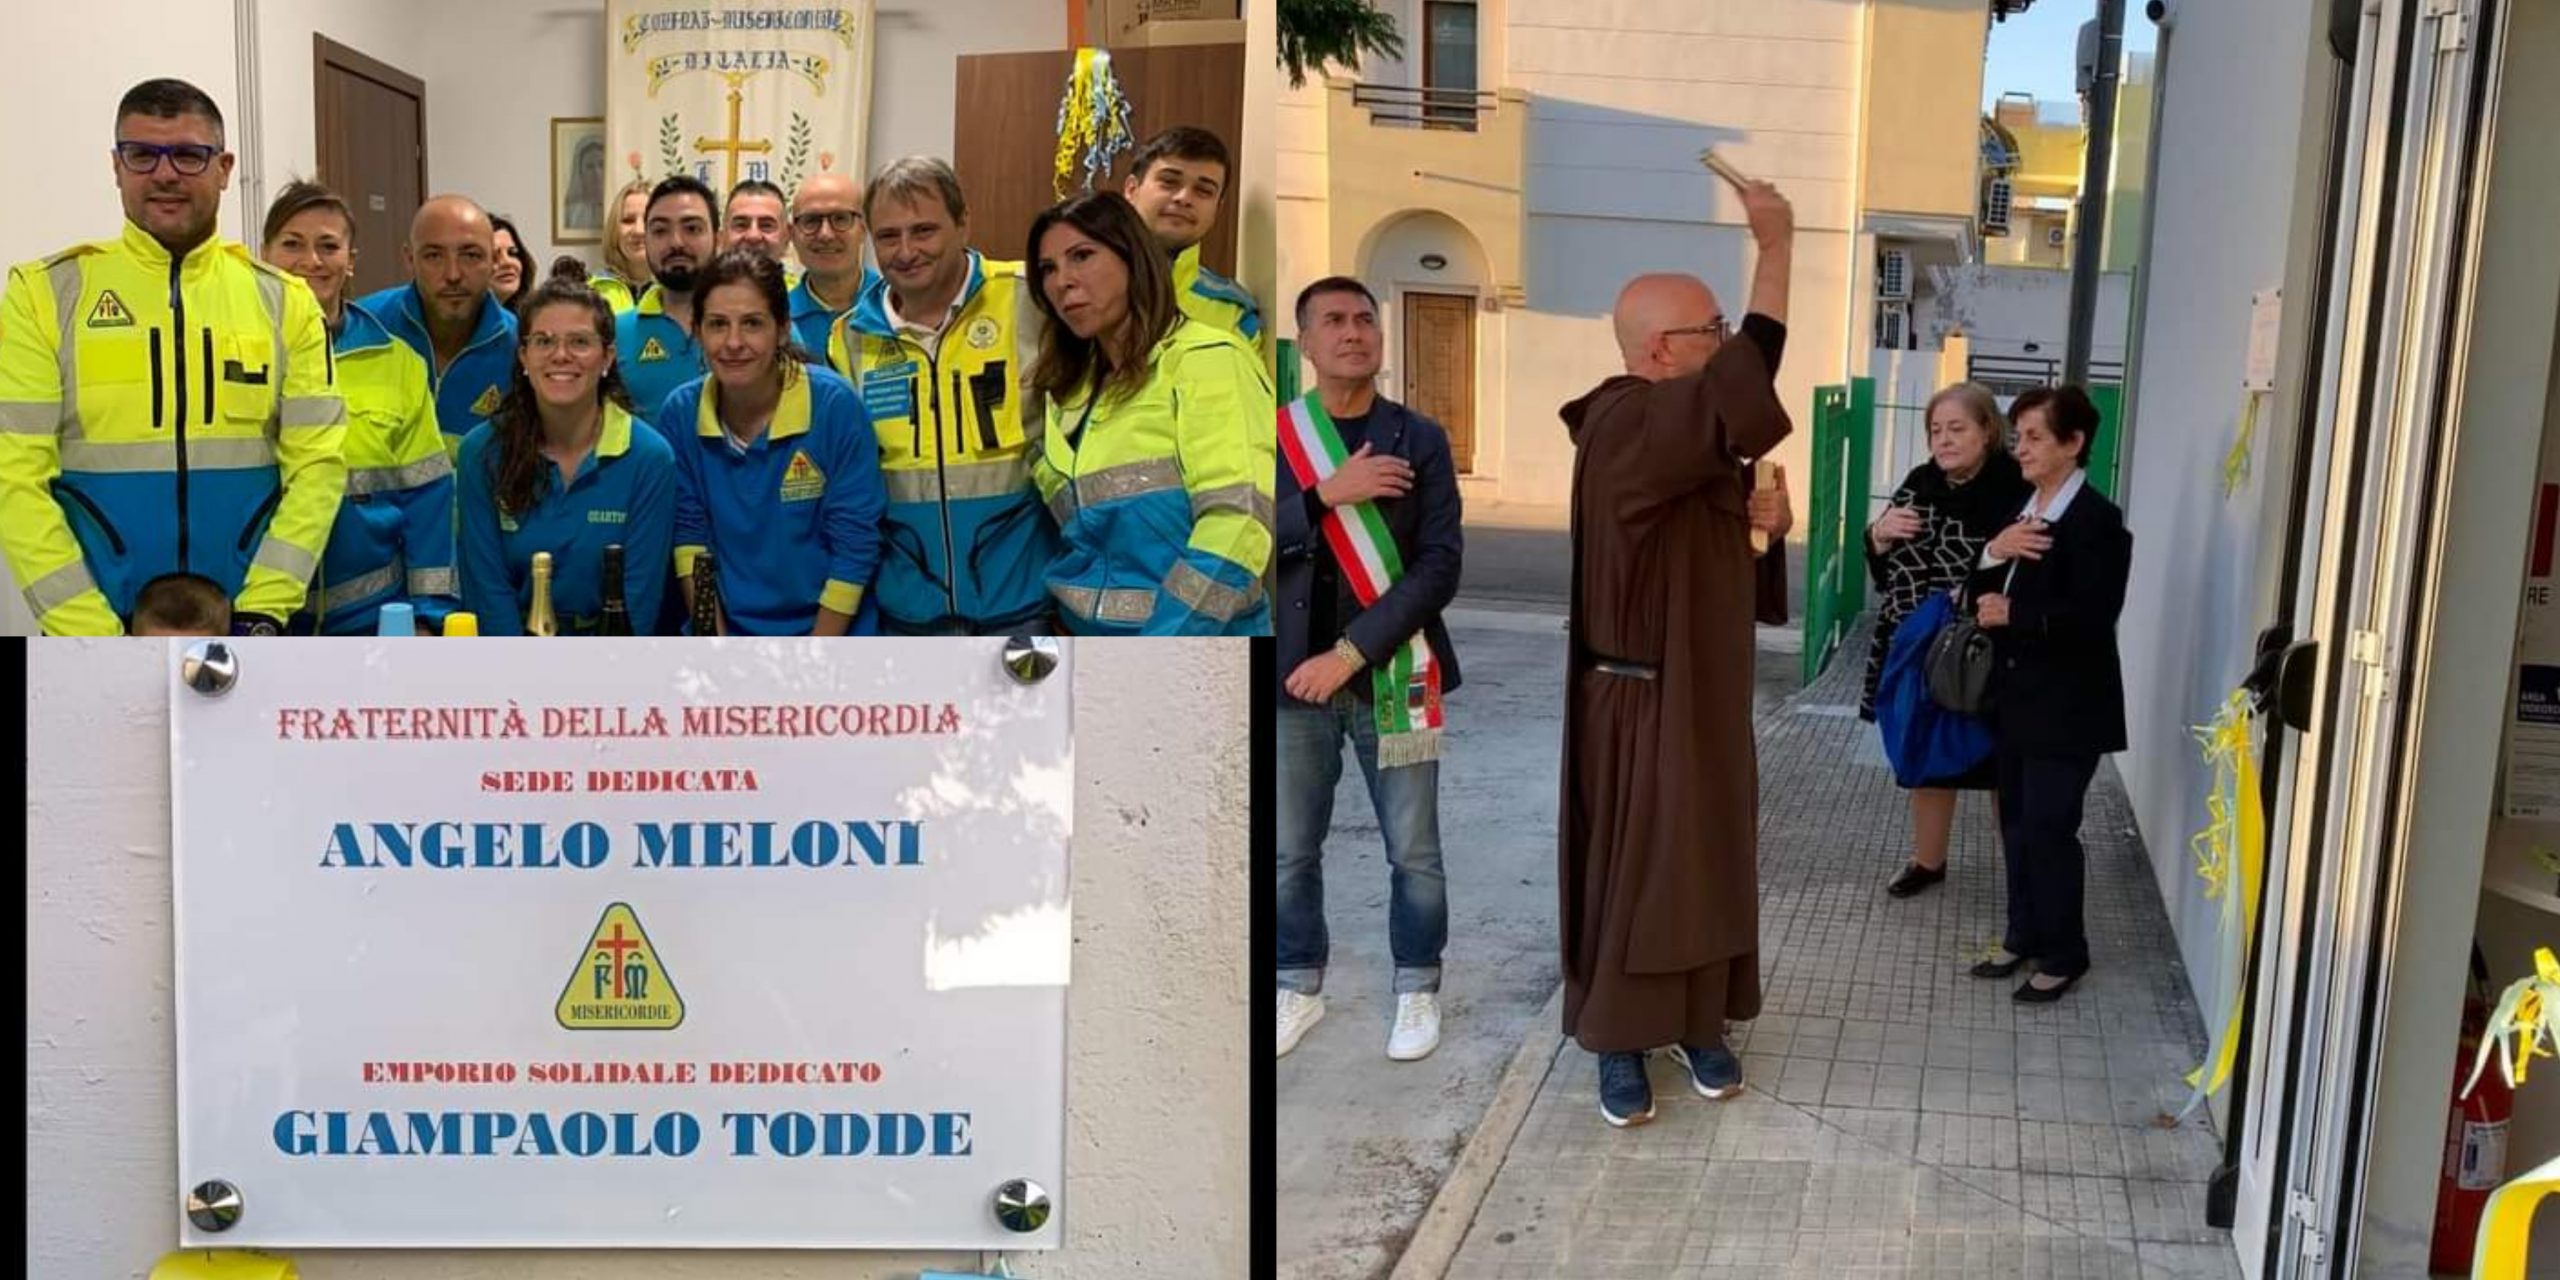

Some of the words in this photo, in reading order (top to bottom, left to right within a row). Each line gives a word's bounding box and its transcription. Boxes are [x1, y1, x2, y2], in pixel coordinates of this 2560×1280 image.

[277, 699, 529, 741] FRATERNITÀ
[542, 705, 669, 739] DELLA
[681, 703, 962, 739] MISERICORDIA
[480, 769, 575, 792] SEDE
[586, 769, 759, 792] DEDICATA
[318, 821, 612, 869] ANGELO
[632, 820, 925, 868] MELONI
[570, 1004, 672, 1020] MISERICORDIE
[361, 1061, 518, 1085] EMPORIO
[527, 1061, 697, 1085] SOLIDALE
[709, 1061, 883, 1084] DEDICATO
[272, 1110, 701, 1158] GIAMPAOLO
[722, 1110, 974, 1157] TODDE
